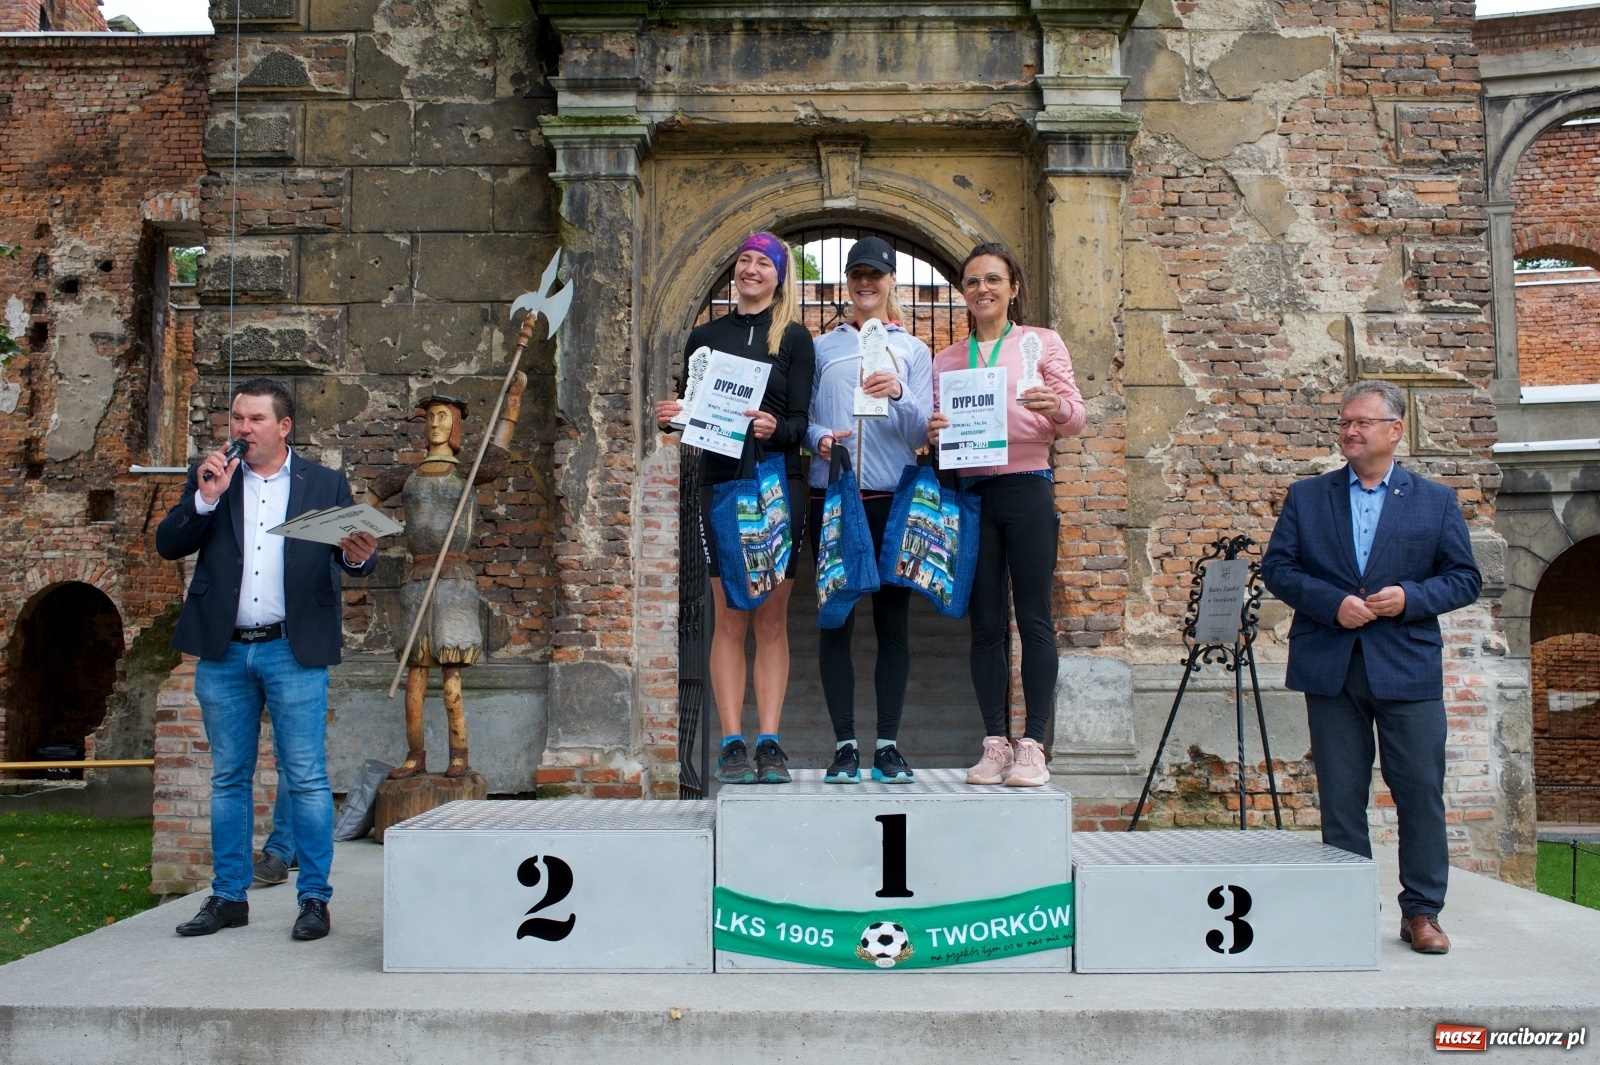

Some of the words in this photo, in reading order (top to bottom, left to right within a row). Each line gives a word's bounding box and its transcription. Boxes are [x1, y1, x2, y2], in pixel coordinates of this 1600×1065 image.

[714, 379, 754, 399] DYPLOM
[952, 393, 994, 409] DYPLOM
[705, 424, 731, 437] 19.09.2021
[958, 440, 989, 450] 19.09.2021
[873, 812, 915, 899] 1
[515, 854, 577, 942] 2
[714, 907, 766, 937] LKS
[775, 921, 834, 947] 1905
[925, 904, 1072, 948] TWORKÓW
[1204, 884, 1255, 956] 3
[1004, 943, 1014, 951] co
[1026, 938, 1043, 946] nas
[1046, 934, 1060, 942] nie
